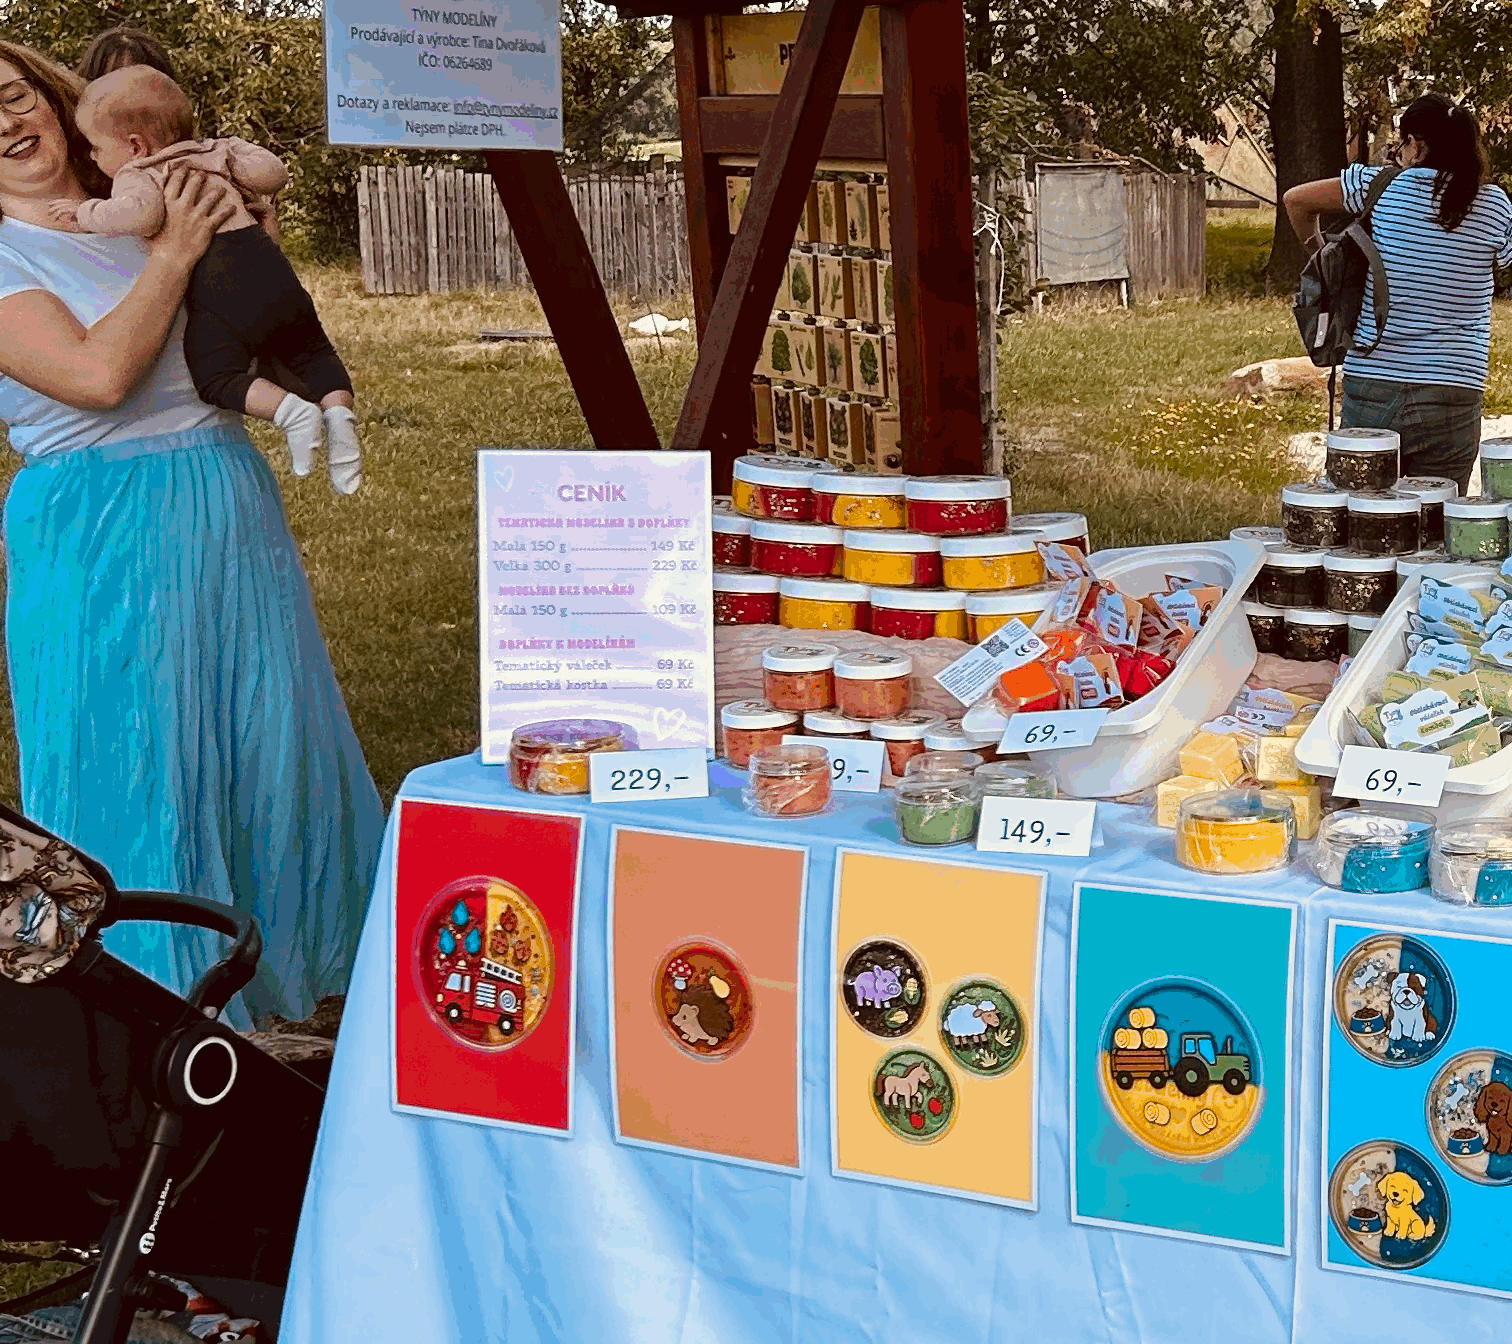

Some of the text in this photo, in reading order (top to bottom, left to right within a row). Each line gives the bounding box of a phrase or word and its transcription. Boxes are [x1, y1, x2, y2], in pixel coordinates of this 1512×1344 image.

[412, 6, 498, 28] TÝNY MODELÍNY
[417, 35, 425, 45] a
[472, 35, 494, 50] Tina
[418, 54, 441, 68] IČO:
[337, 94, 380, 113] Dotazy
[382, 99, 390, 110] a
[392, 97, 450, 113] reklamace:
[405, 120, 446, 138] Nejsem
[557, 481, 627, 503] CENÍK
[530, 540, 555, 552] 150
[559, 543, 567, 554] g
[651, 540, 674, 552] 149
[678, 539, 696, 552] Kč
[534, 560, 560, 571] 300
[564, 563, 572, 573] g
[652, 560, 677, 571] 229
[681, 559, 698, 571] Kč
[531, 604, 556, 616] 150
[559, 608, 568, 618] g
[652, 604, 676, 616] 109
[657, 659, 674, 670] 69
[677, 659, 694, 670] Kč
[656, 679, 673, 690] 69
[677, 678, 693, 690] Kč
[1024, 724, 1077, 744] 69,-
[611, 768, 689, 792] 229,-
[1365, 769, 1422, 796] 69,-
[1000, 818, 1071, 847] 149,-
